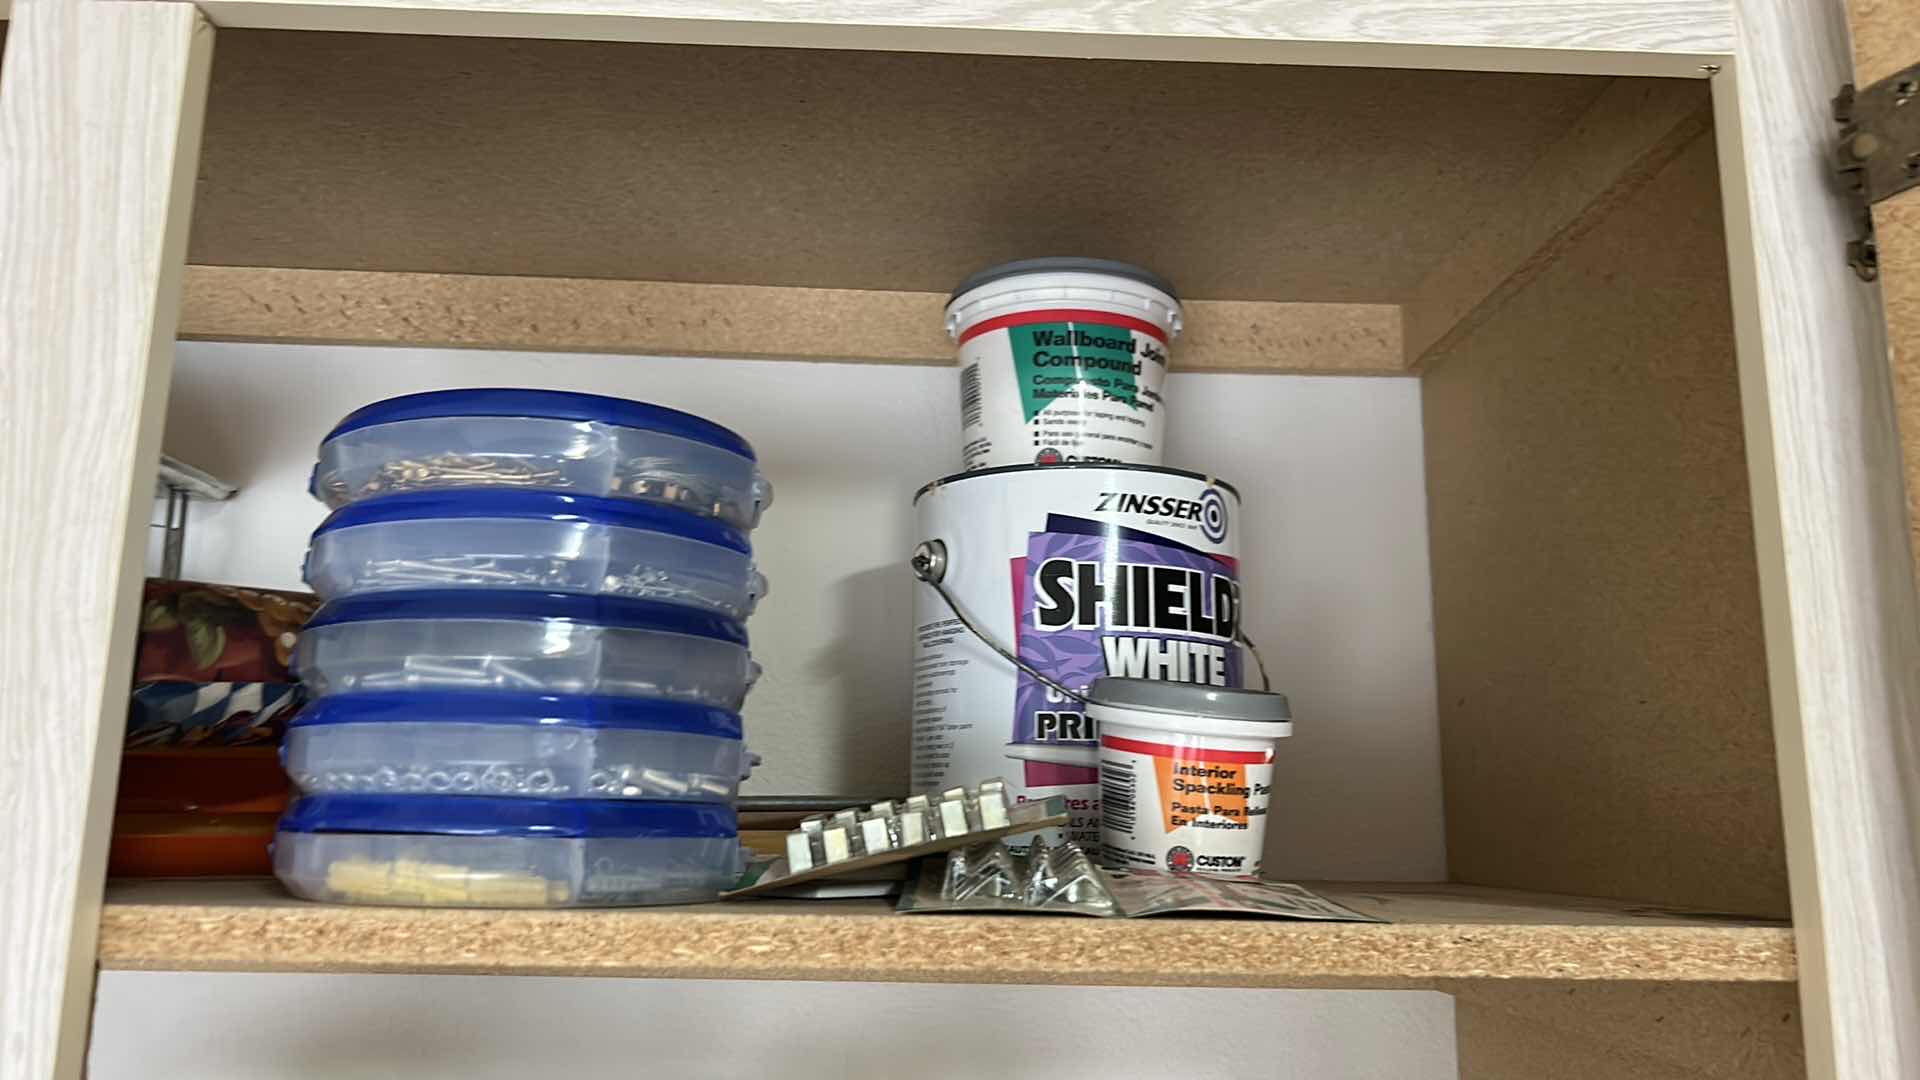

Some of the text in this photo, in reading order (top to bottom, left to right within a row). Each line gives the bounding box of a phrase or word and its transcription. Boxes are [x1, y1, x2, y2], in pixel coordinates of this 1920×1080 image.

[1032, 330, 1136, 354] Wallboard
[1033, 351, 1142, 376] Compound
[1094, 492, 1203, 521] ZINSSER
[1034, 557, 1241, 647] SHIELD
[1102, 635, 1226, 687] WHITE
[1174, 763, 1237, 779] Interior
[1172, 779, 1250, 799] Spackling
[1171, 802, 1209, 815] Pasta
[1213, 805, 1240, 816] Para
